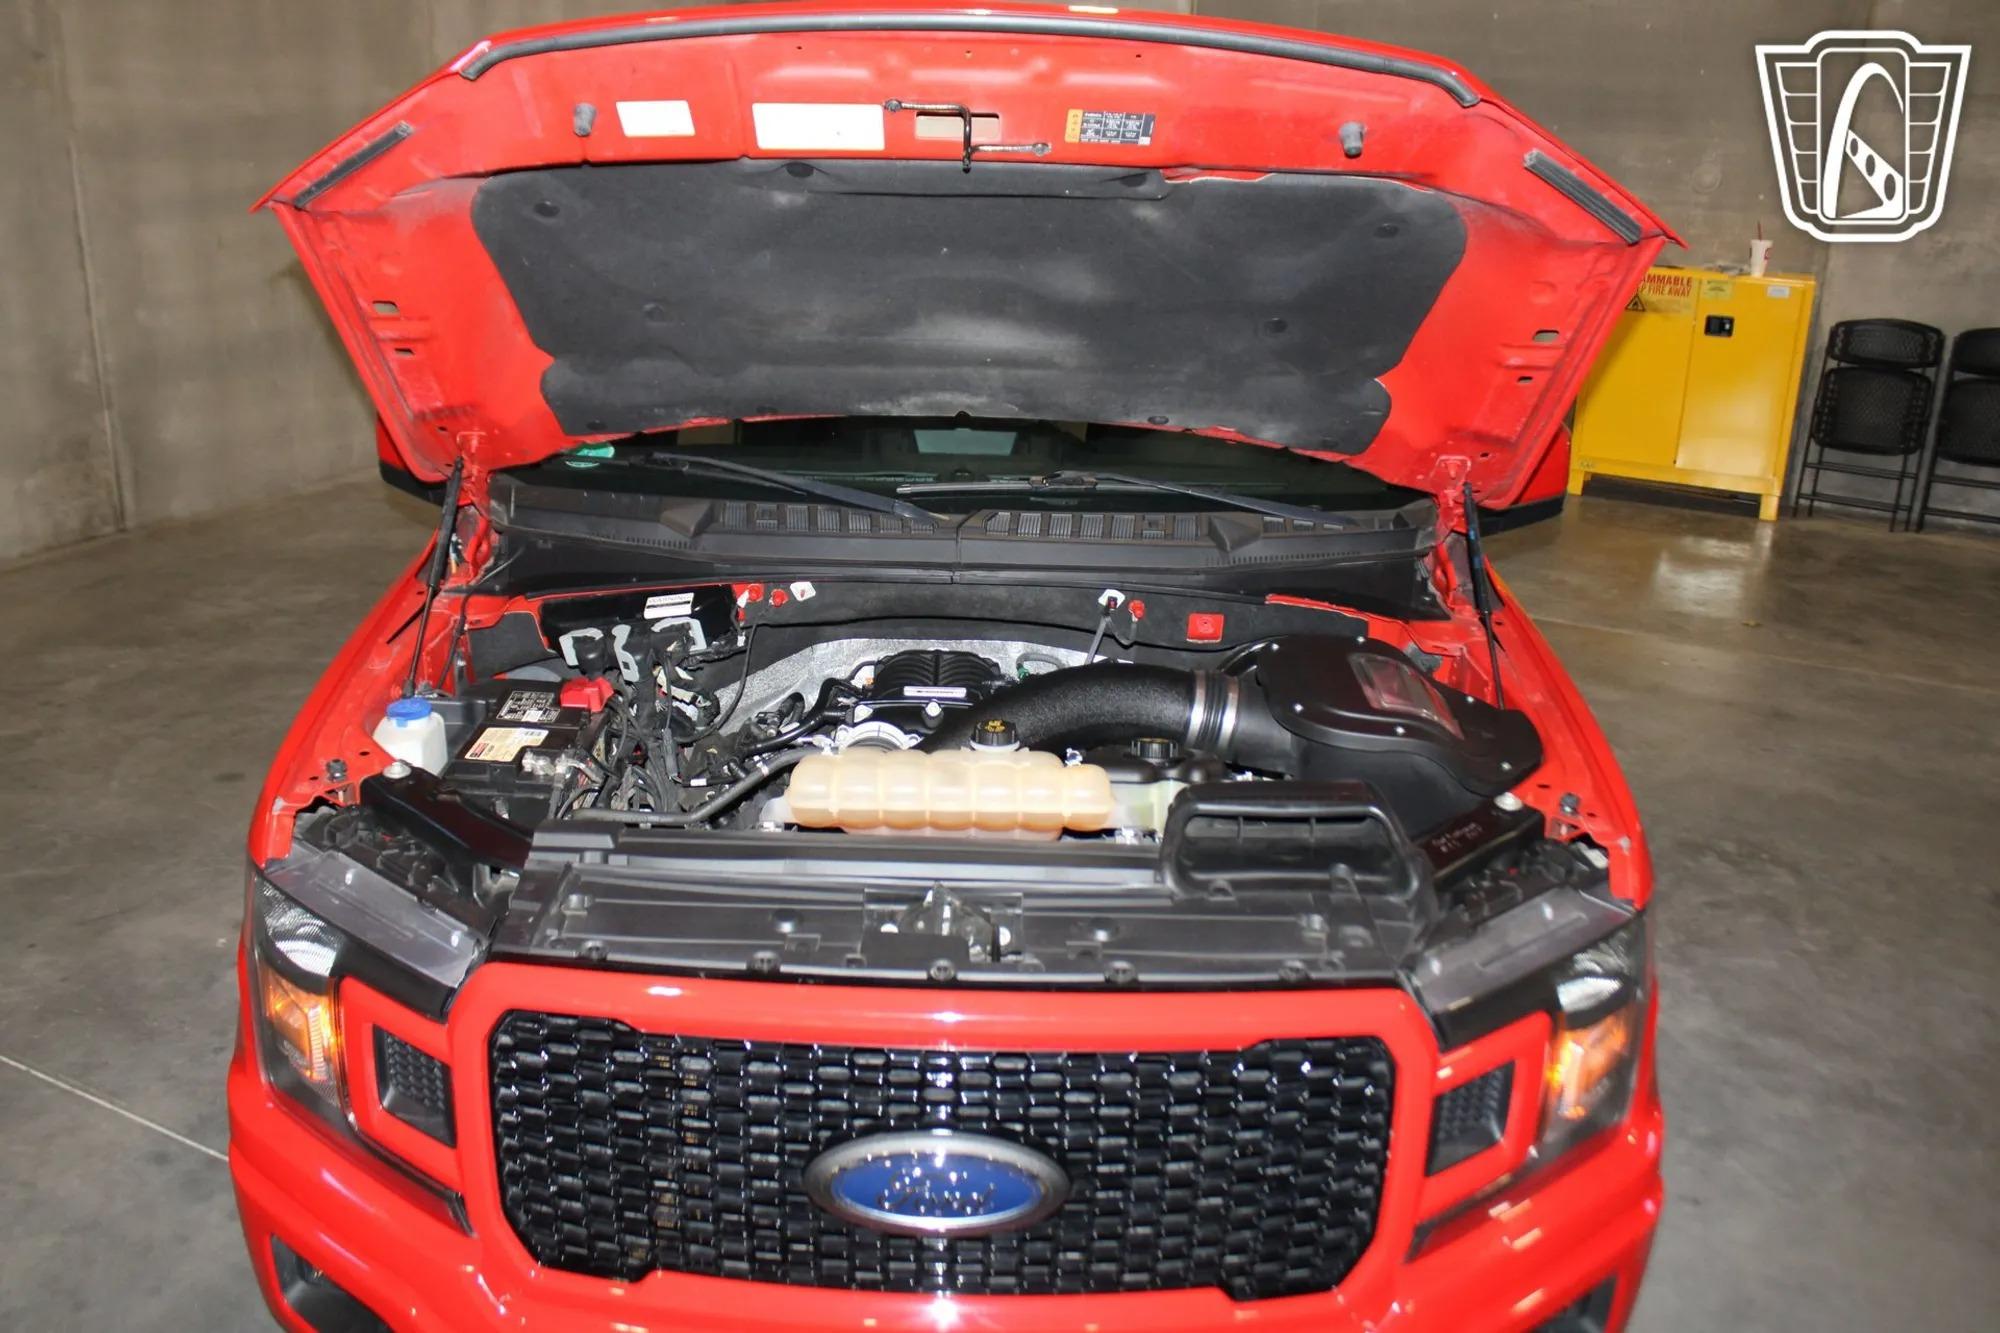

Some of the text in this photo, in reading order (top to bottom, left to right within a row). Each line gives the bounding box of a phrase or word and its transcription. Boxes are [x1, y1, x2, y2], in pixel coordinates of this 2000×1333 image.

[1642, 273, 1692, 287] AMMABLE
[1648, 285, 1665, 296] FIRE
[1667, 286, 1691, 297] AWAY
